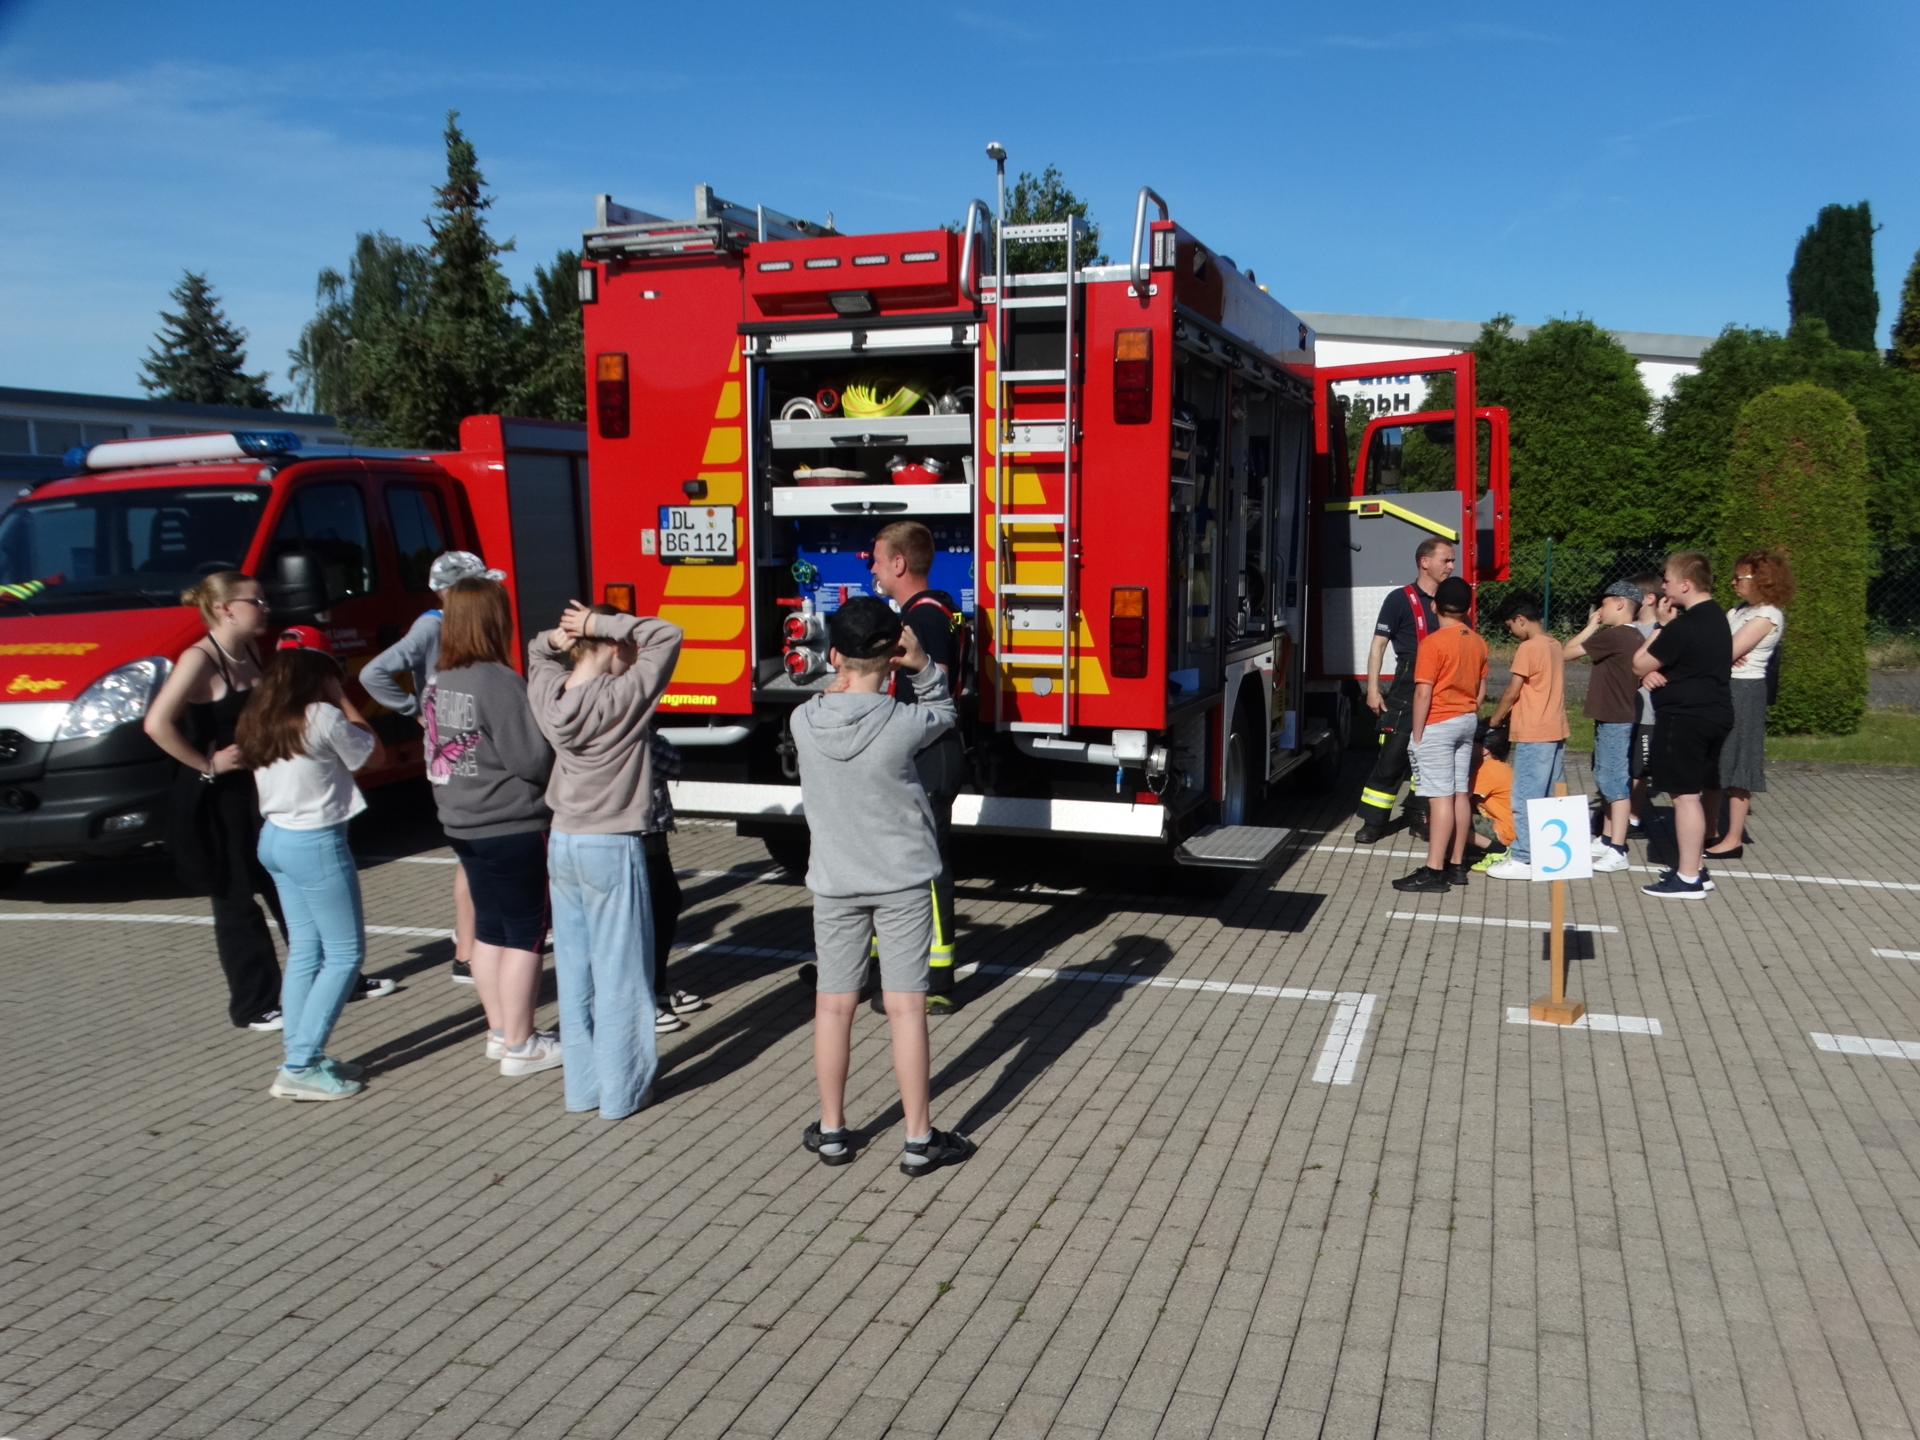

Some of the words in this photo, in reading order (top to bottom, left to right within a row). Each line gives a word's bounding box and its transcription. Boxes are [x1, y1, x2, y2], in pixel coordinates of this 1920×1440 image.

[672, 511, 695, 530] DL
[666, 533, 689, 552] BG
[694, 533, 727, 552] 112
[1540, 818, 1572, 873] 3
